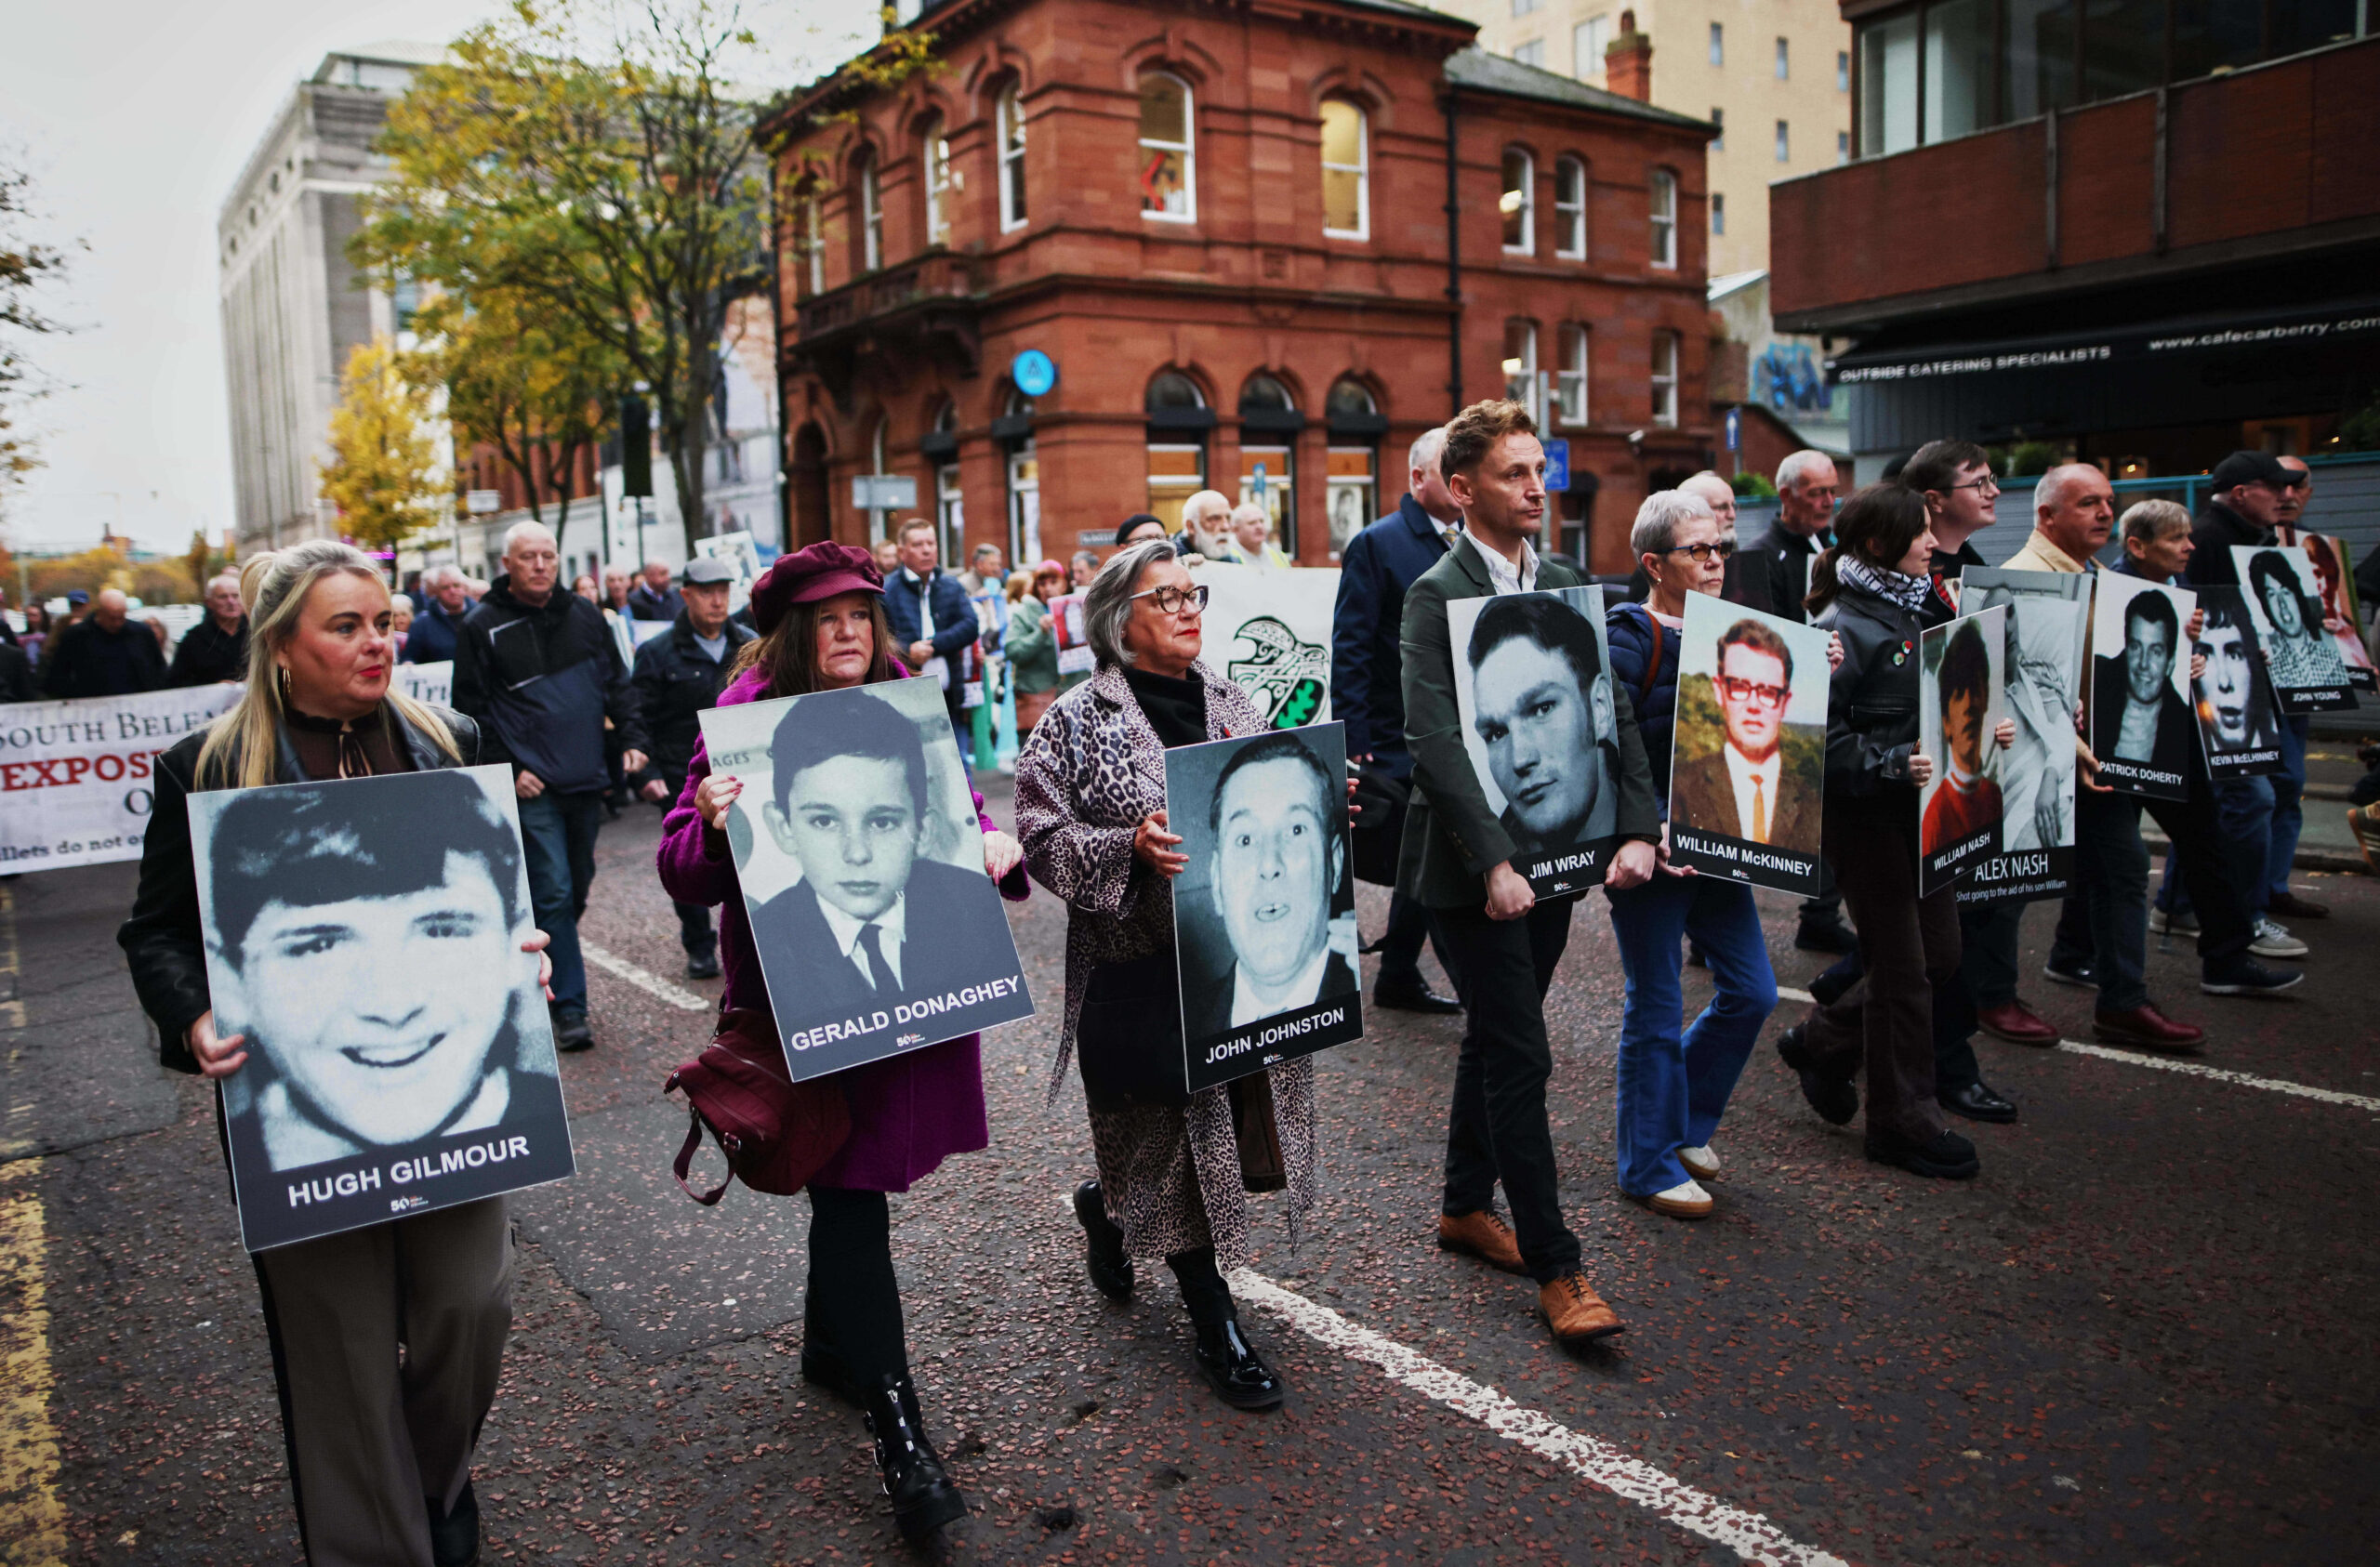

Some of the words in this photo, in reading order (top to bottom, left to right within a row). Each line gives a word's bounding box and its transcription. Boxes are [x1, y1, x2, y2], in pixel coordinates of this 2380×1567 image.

[1839, 363, 1906, 383] OUTSIDE
[1909, 357, 1992, 376] CATERING
[1996, 346, 2110, 369] SPECIALISTS
[2293, 692, 2313, 702] JOHN
[2314, 691, 2341, 700] YOUNG
[0, 721, 105, 749] OUTH
[116, 706, 230, 740] BELF
[0, 749, 164, 791] EXPOS
[712, 751, 749, 769] AGES
[2099, 761, 2138, 778] PATRICK
[2140, 768, 2183, 785] DOHERTY
[2210, 755, 2233, 766] KEVIN
[2233, 750, 2280, 765] McELHINNEY
[0, 844, 49, 862] llets
[57, 840, 83, 854] do
[89, 835, 122, 850] not
[1529, 858, 1553, 880] JIM
[1554, 849, 1596, 874] WRAY
[1676, 834, 1738, 861] WILLIAM
[1741, 844, 1813, 877] McKINNEY
[1934, 843, 1966, 871] WILLIAM
[1968, 831, 1990, 853] NASH
[1975, 857, 2008, 882] ALEX
[2012, 852, 2048, 877] NASH
[1956, 890, 1970, 902] Shot
[1971, 889, 1989, 903] going
[1990, 889, 1997, 898] to
[1997, 887, 2007, 897] the
[2008, 885, 2017, 895] aid
[2018, 883, 2026, 894] of
[2034, 883, 2045, 891] son
[2045, 879, 2067, 889] William
[790, 1011, 890, 1052] GERALD
[894, 975, 1020, 1026] DONAGHEY
[1205, 1035, 1251, 1064] JOHN
[1256, 1007, 1345, 1048] JOHNSTON
[287, 1166, 382, 1208] HUGH
[390, 1135, 531, 1185] GILMOUR
